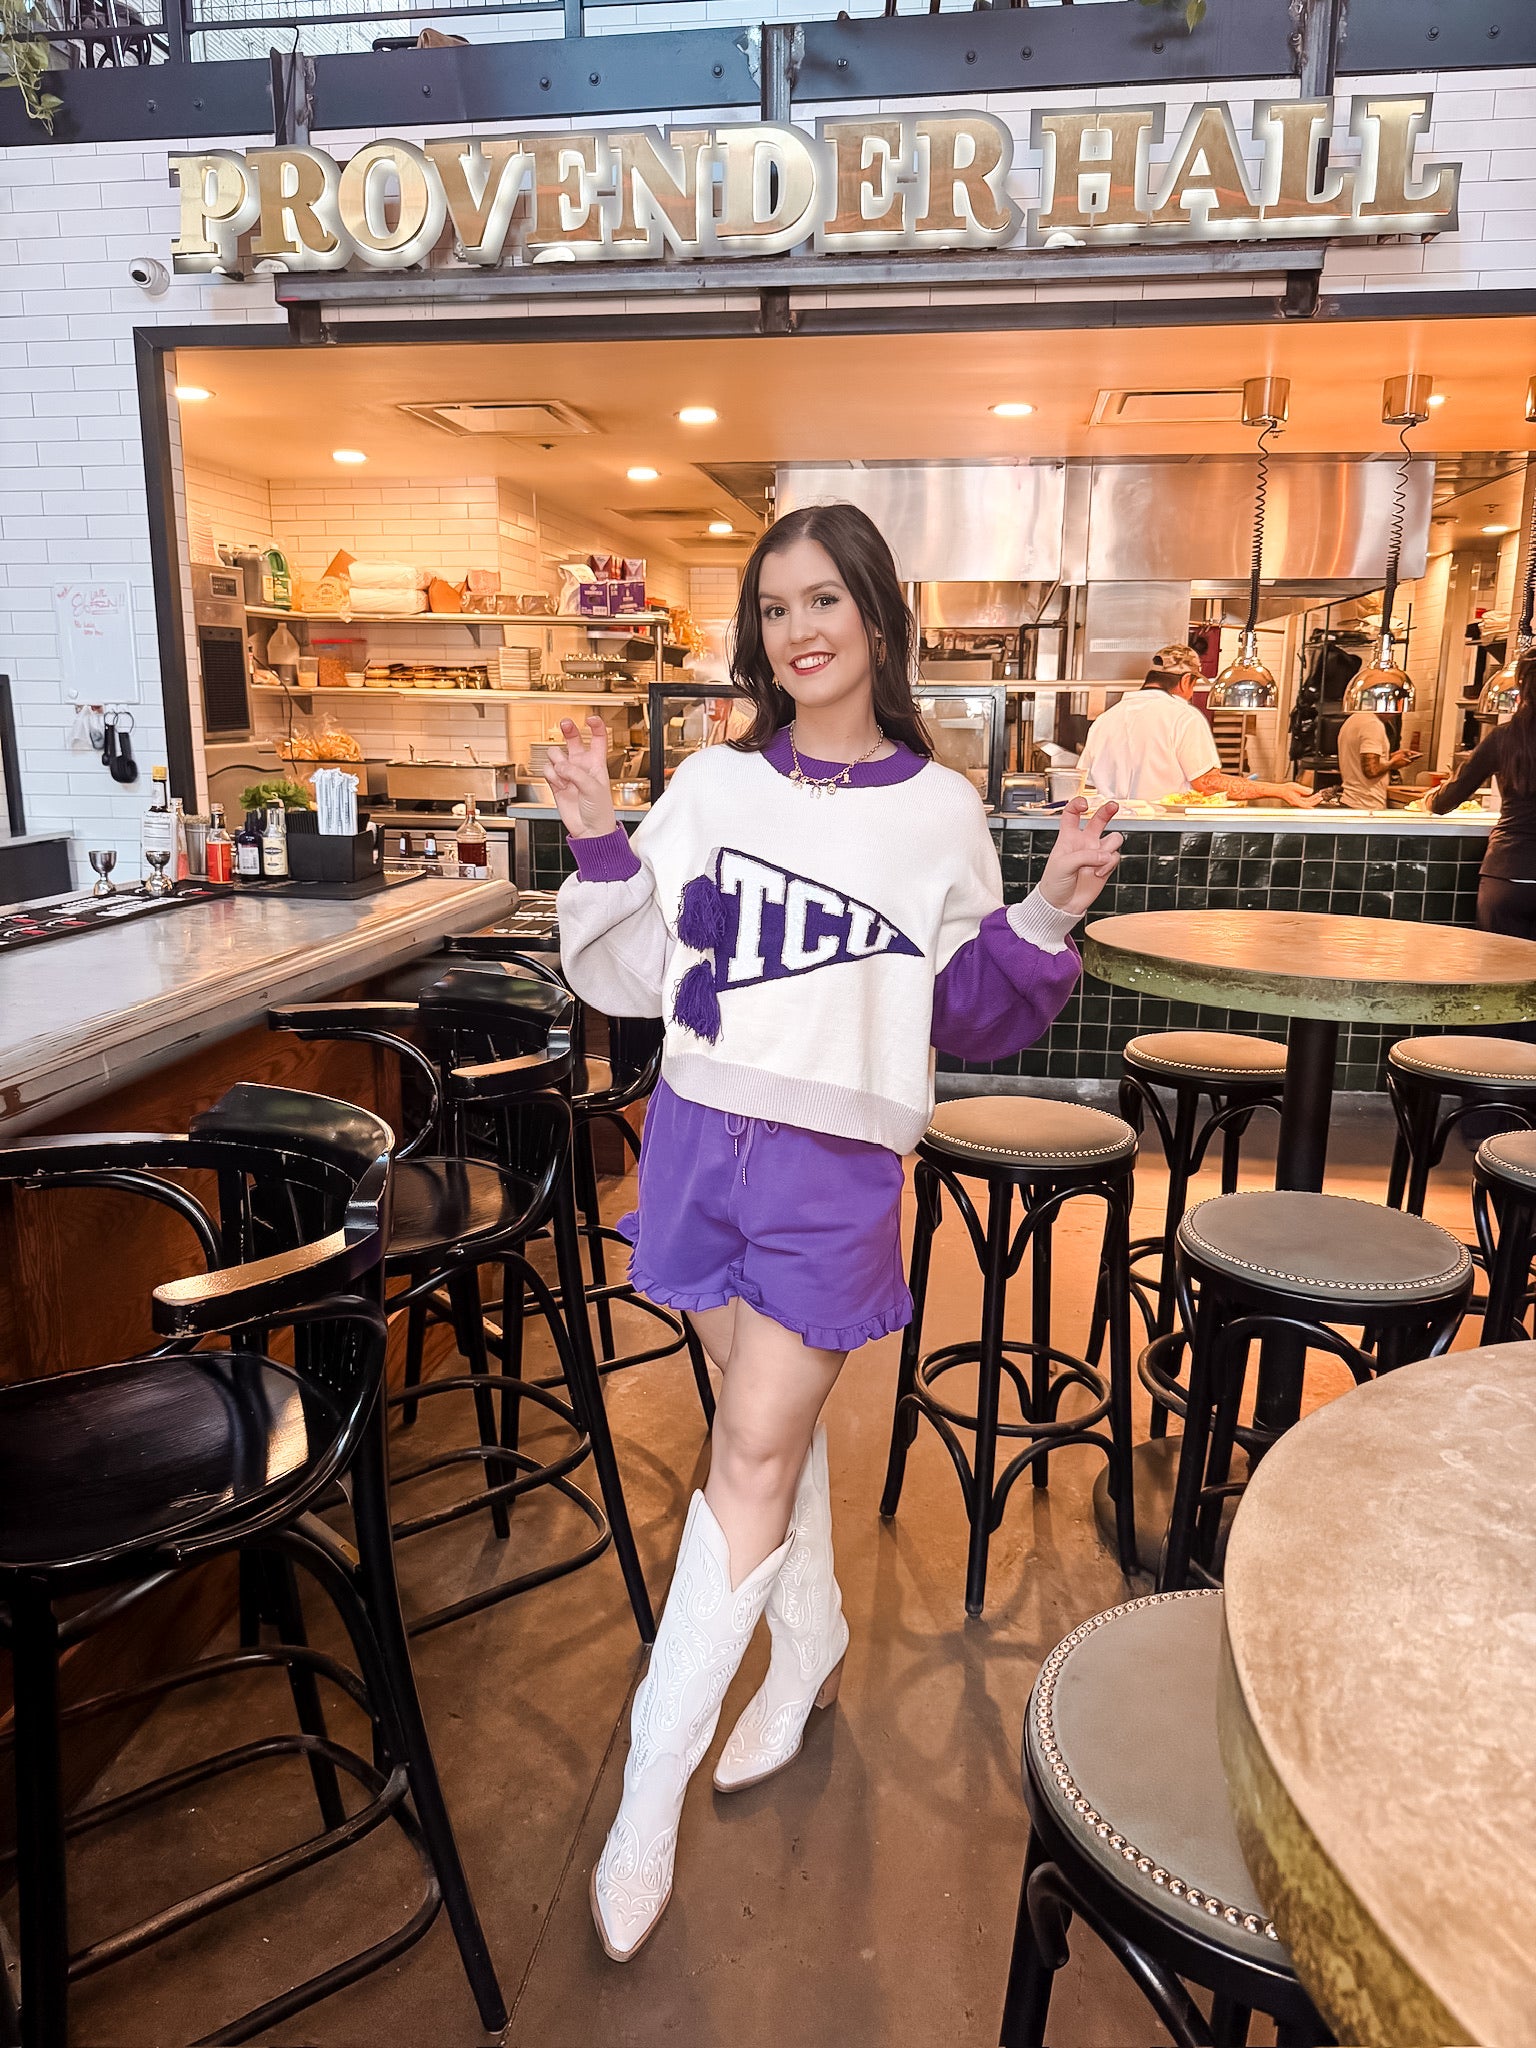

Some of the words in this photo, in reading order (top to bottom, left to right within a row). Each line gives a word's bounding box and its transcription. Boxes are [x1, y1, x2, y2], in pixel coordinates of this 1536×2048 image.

[169, 113, 1018, 266] PROVENDER
[1033, 97, 1459, 239] HALL
[719, 850, 899, 984] TCU
